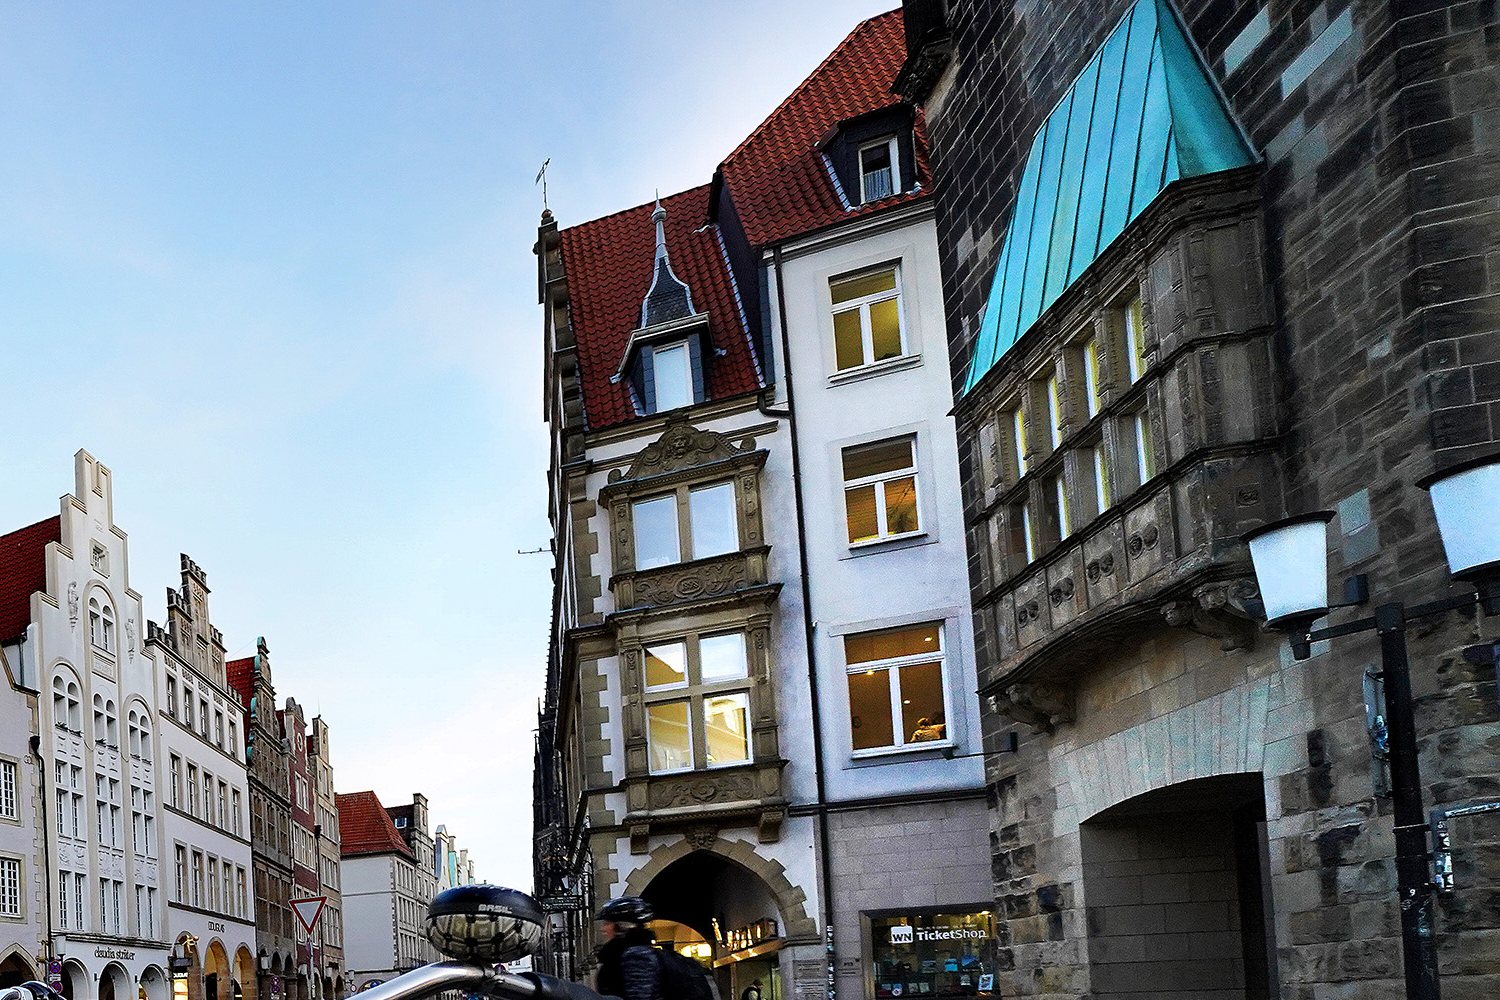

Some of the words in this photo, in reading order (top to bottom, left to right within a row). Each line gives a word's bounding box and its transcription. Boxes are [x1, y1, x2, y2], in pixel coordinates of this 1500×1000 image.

[1305, 633, 1311, 641] 2
[478, 904, 513, 914] BASIL
[892, 932, 912, 942] WN
[916, 929, 986, 941] TicketShop
